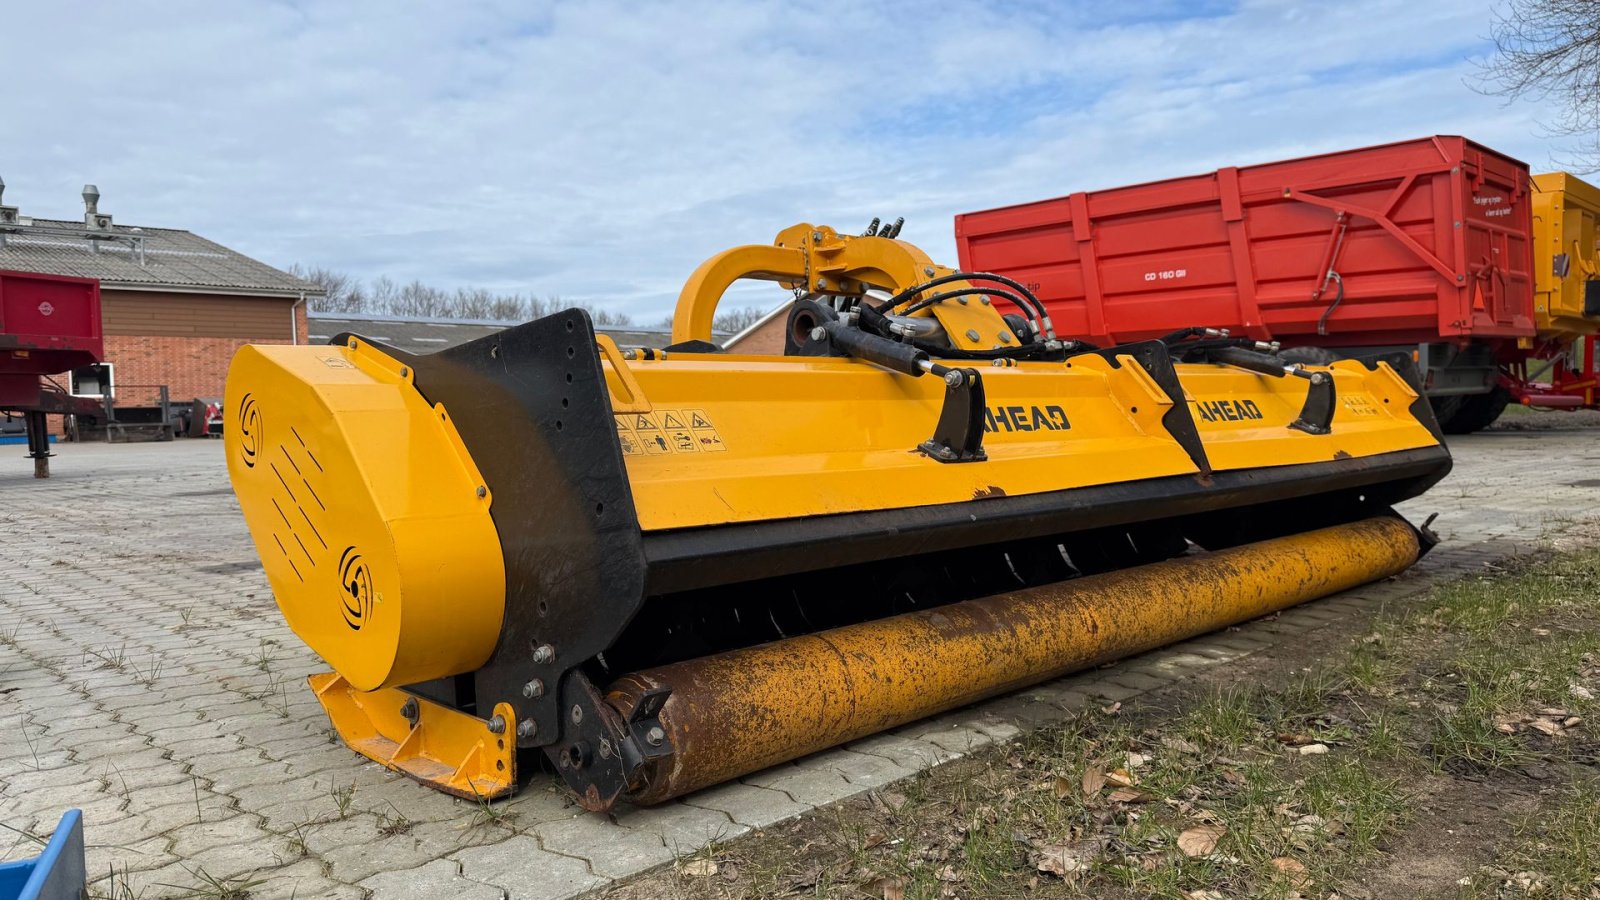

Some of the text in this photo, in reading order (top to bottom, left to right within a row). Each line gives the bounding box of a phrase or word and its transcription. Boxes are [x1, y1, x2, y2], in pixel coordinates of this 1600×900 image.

[1158, 270, 1175, 280] 160
[984, 405, 1072, 432] HEAD
[1196, 399, 1264, 422] AHEAD
